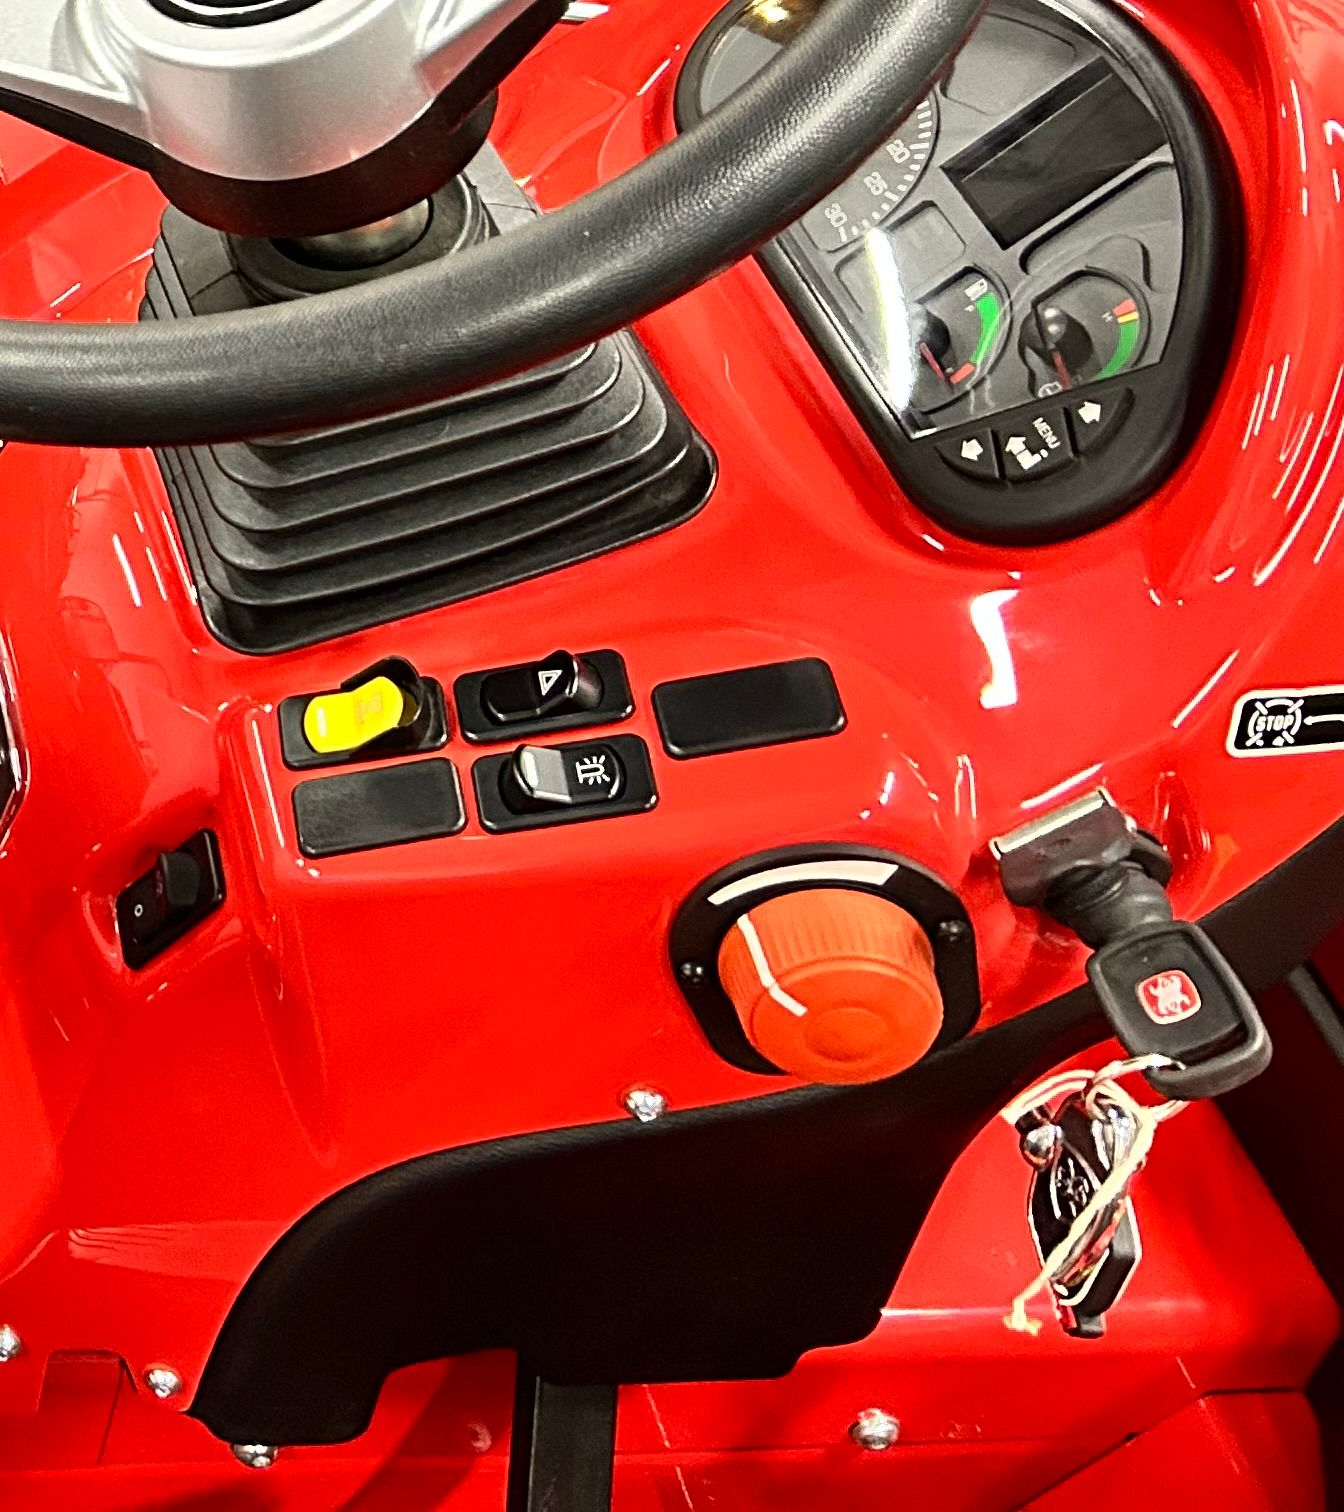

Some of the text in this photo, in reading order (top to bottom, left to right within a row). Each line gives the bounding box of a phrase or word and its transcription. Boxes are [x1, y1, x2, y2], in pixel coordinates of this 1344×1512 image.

[886, 139, 911, 164] 20
[863, 171, 888, 196] 25
[824, 202, 848, 228] 30
[1032, 416, 1062, 450] MENU
[1255, 714, 1295, 732] STOP
